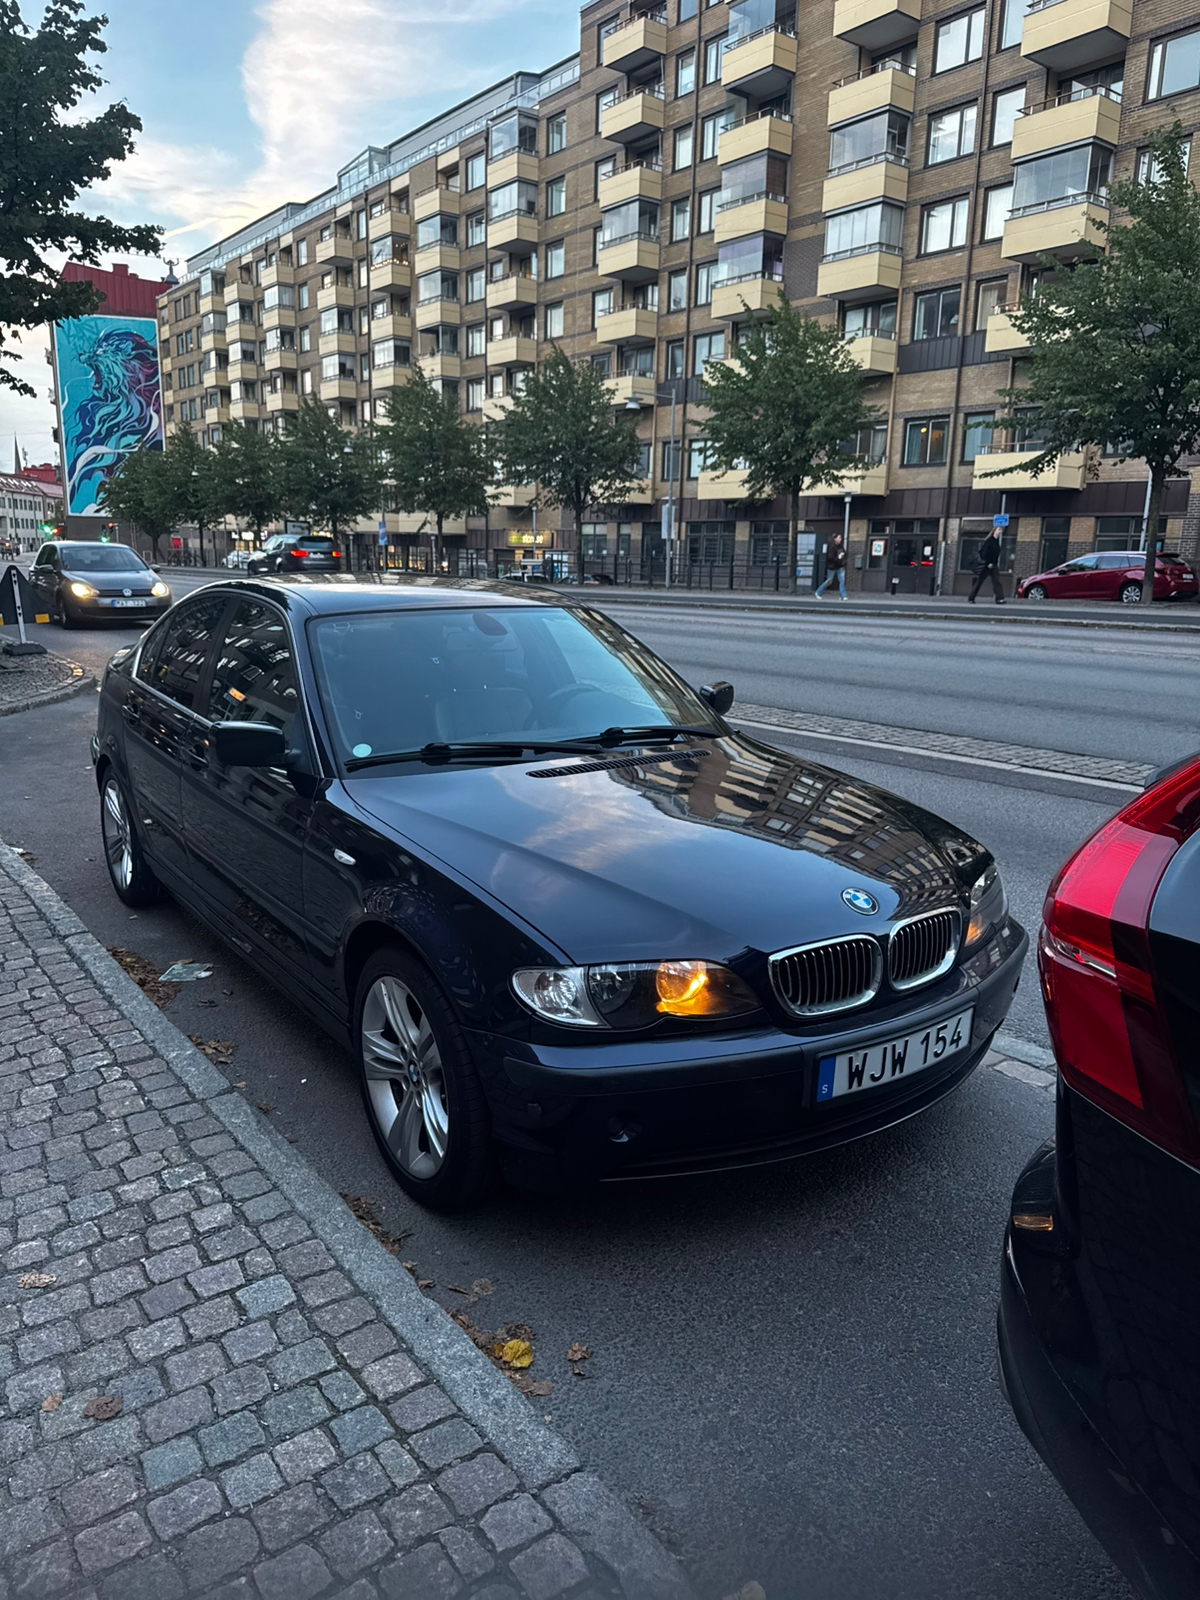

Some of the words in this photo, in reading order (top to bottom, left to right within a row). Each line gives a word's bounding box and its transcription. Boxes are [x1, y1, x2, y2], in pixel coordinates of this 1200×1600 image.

[847, 1038, 909, 1090] WJW
[920, 1016, 963, 1065] 154
[821, 1084, 829, 1094] S
